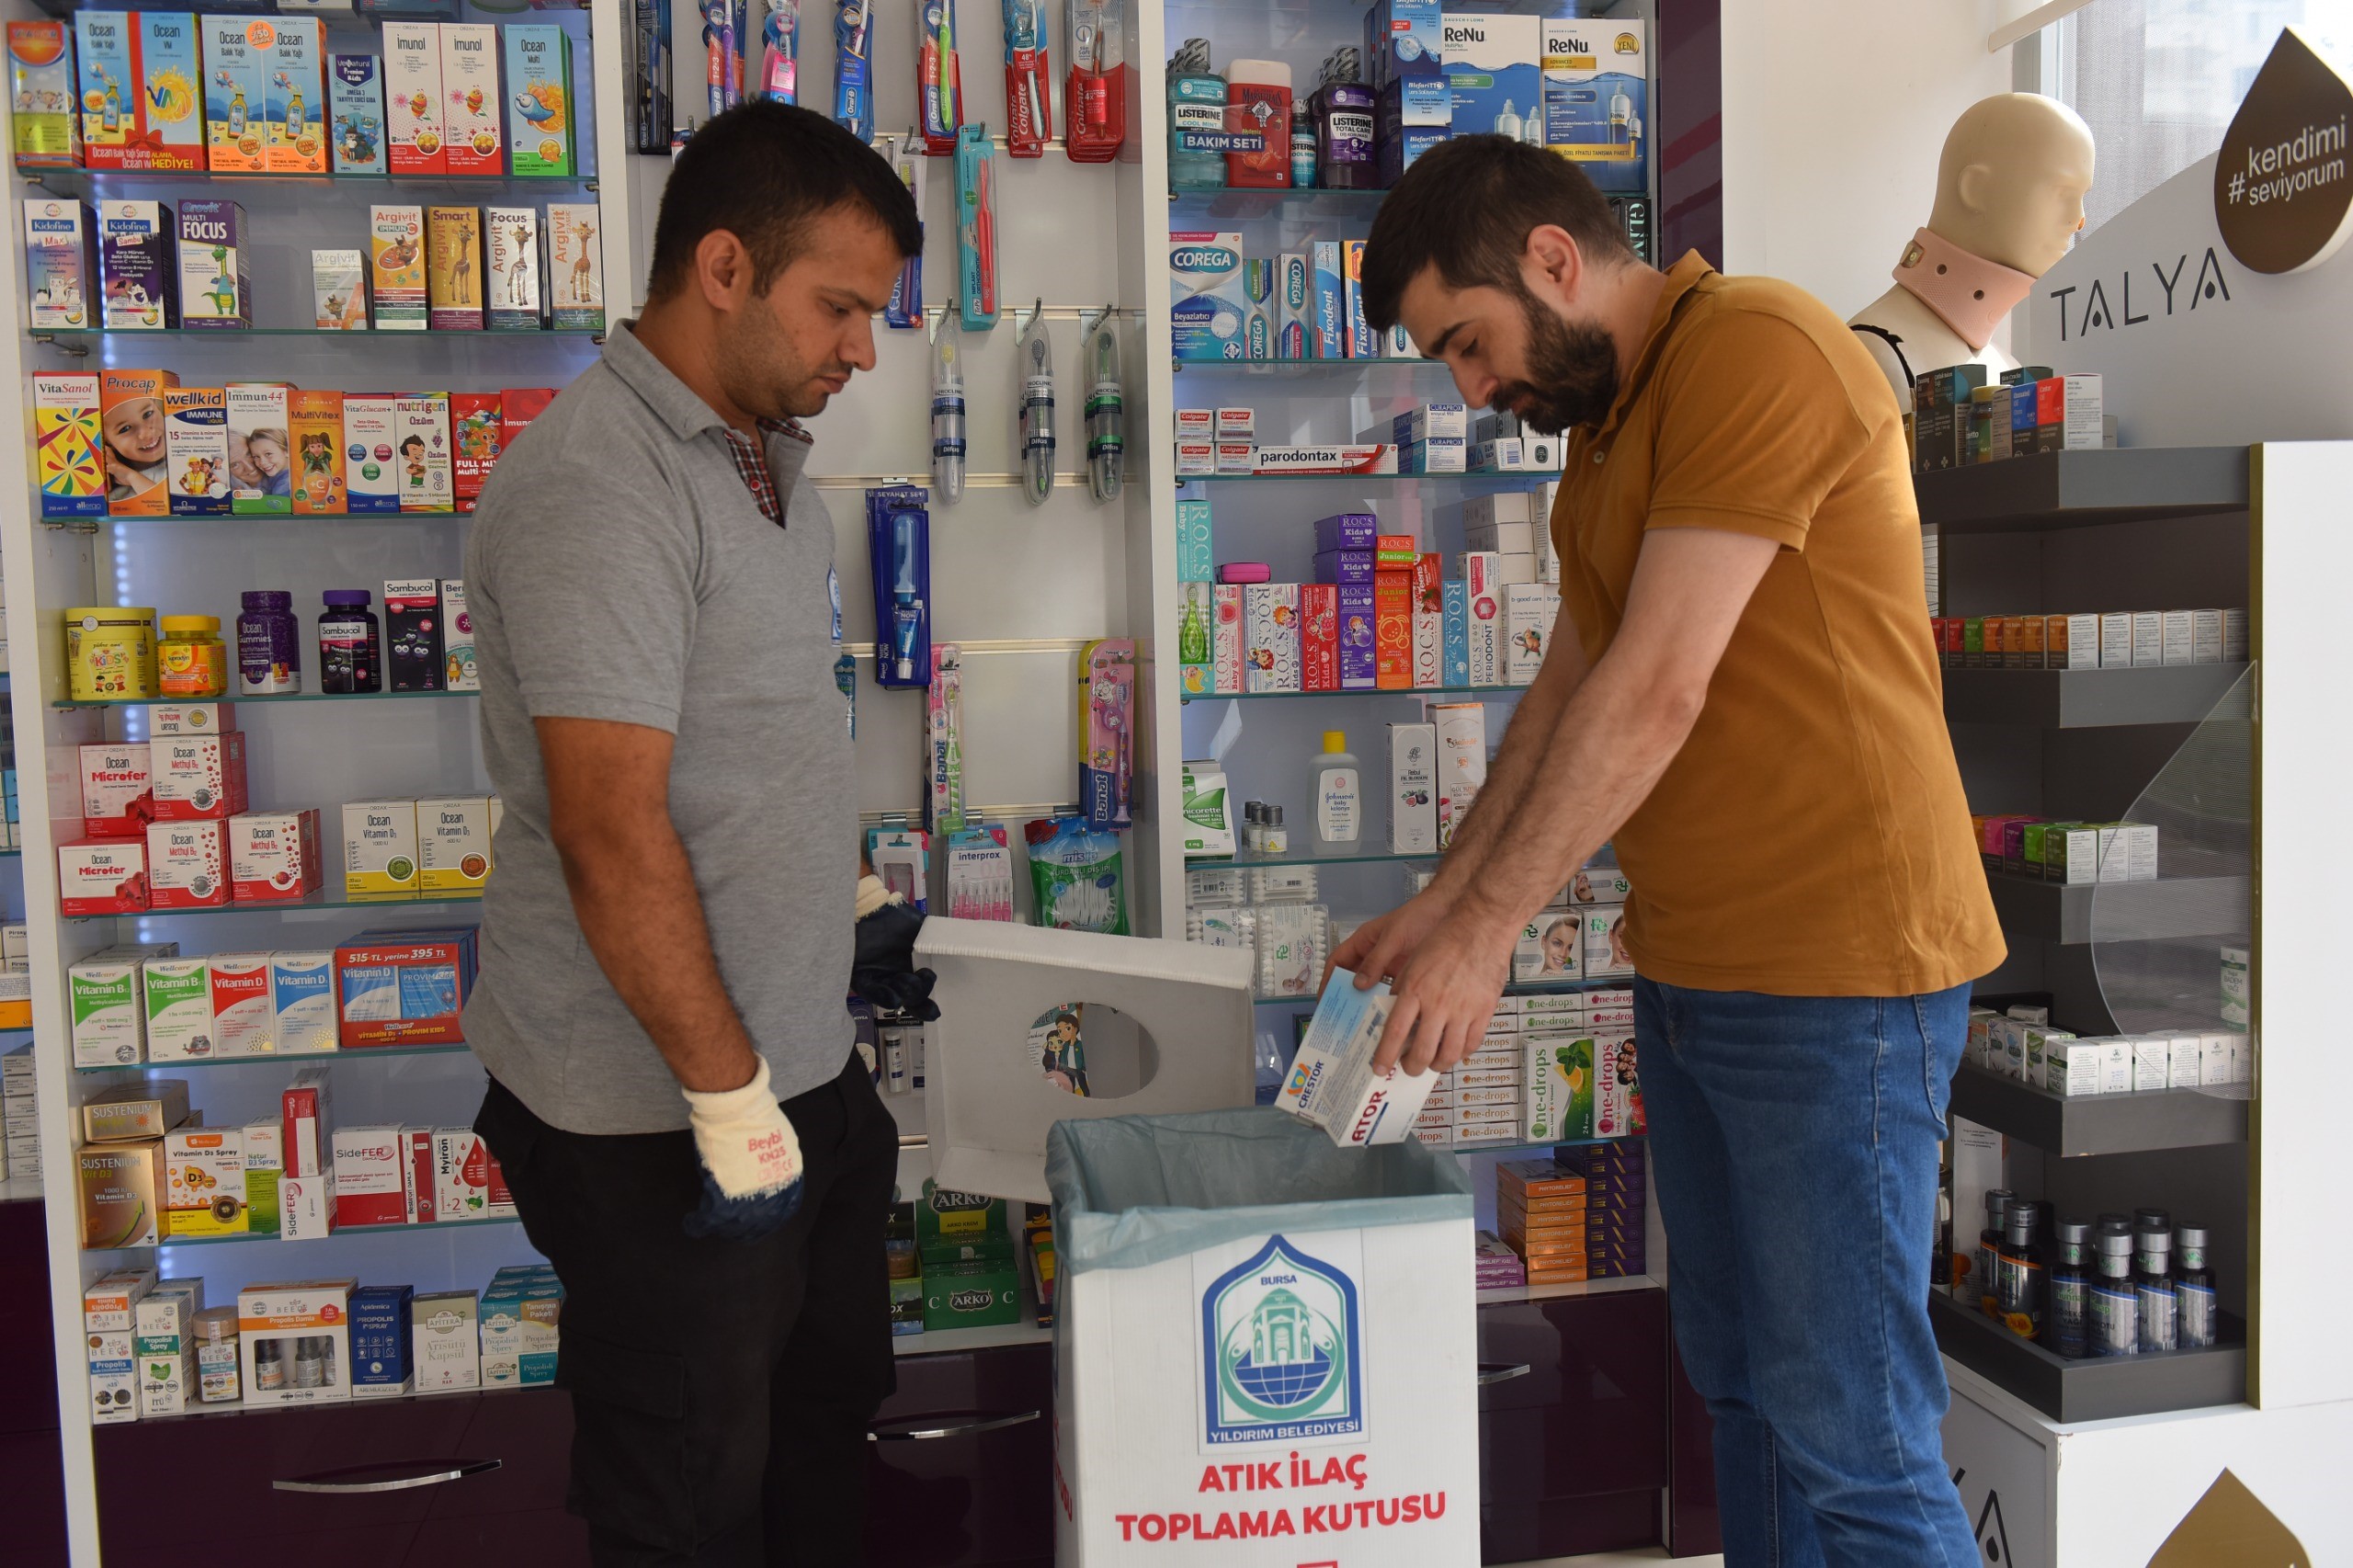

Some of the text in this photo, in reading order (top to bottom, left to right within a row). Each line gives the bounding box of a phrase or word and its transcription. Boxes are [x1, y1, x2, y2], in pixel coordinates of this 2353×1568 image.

[89, 24, 115, 37] Ocean
[154, 26, 180, 39] Ocean
[1444, 28, 1484, 41] ReNu
[220, 31, 244, 45] Ocean
[278, 33, 303, 46] Ocean
[397, 35, 426, 51] İmunol
[454, 36, 482, 51] İmunol
[521, 40, 546, 53] Ocean
[1550, 39, 1588, 53] ReNu
[1617, 40, 1636, 51] YENİ
[1017, 83, 1027, 135] Colgate
[1076, 83, 1086, 134] Colgate
[1178, 108, 1221, 120] LISTERINE
[1334, 118, 1372, 128] LISTERINE
[1187, 135, 1262, 149] BAKIM SETİ
[2249, 115, 2346, 177] kendimi
[122, 157, 142, 168] Ocean
[152, 155, 193, 169] HEDİYE!
[2249, 158, 2344, 206] seviyorum
[376, 211, 416, 222] Argivit
[433, 210, 471, 222] Smart
[491, 211, 527, 223] Focus
[34, 222, 71, 232] Kidofine
[110, 222, 147, 232] Kidofine
[184, 222, 227, 240] FOCUS
[554, 210, 567, 263] Argivit
[436, 223, 447, 272] Argivit
[493, 226, 504, 273] Argivit
[1174, 252, 1232, 267] COREGA
[1291, 262, 1302, 305] COREGA
[2051, 246, 2231, 341] TALYA
[973, 300, 982, 315] TePe
[1174, 312, 1210, 322] Beyazlatıcı
[1324, 290, 1335, 345] Fixodent
[39, 383, 92, 393] VitaSanol
[107, 377, 155, 392] Procap
[165, 392, 222, 405] wellkid
[345, 404, 392, 414] VitaGlucan+
[397, 401, 446, 413] nutrigen
[187, 411, 223, 419] IMMUNE
[291, 411, 339, 419] MultiVitex
[409, 415, 434, 426] Üzüm
[1261, 450, 1337, 466] parodontax
[1380, 552, 1404, 561] Junior
[387, 583, 433, 593] Sambucol
[243, 622, 261, 633] Ocean
[323, 626, 360, 635] Sambucol
[1322, 663, 1330, 688] Kids
[174, 747, 195, 758] Ocean
[106, 757, 130, 769] Ocean
[171, 760, 190, 770] Methyl
[936, 739, 946, 782] Banat
[92, 770, 146, 782] Microfer
[1096, 775, 1108, 823] Banat
[1183, 806, 1222, 815] nicorette
[368, 815, 391, 826] Ocean
[363, 829, 388, 839] Vitamin
[92, 855, 111, 864] Ocean
[959, 851, 1001, 862] interprox
[79, 866, 125, 876] Microfer
[349, 953, 368, 963] 515
[384, 953, 409, 962] yerine
[411, 949, 433, 959] 395
[75, 984, 117, 994] Vitamin
[215, 978, 253, 988] Vitamin
[358, 1031, 386, 1040] VİTAMİN
[1299, 1060, 1324, 1108] CRESTOR
[93, 1105, 153, 1119] SUSTENIUM
[1351, 1089, 1387, 1142] ATOR
[748, 1130, 783, 1152] Beybi
[216, 1149, 237, 1158] Sprey
[336, 1149, 384, 1158] SideFER
[441, 1139, 449, 1175] Myiron
[82, 1157, 141, 1169] SUSTENIUM
[83, 1170, 111, 1179] Vit D3
[938, 1193, 989, 1208] ARKO
[288, 1193, 297, 1235] SideFER
[1260, 1274, 1297, 1285] BURSA
[928, 1297, 939, 1309] C
[954, 1294, 990, 1305] ARKO
[1003, 1291, 1014, 1304] C
[1211, 1419, 1359, 1443] YILDIRIM BELEDİYESİ
[1199, 1451, 1368, 1494] ATIK İLAÇ
[1116, 1492, 1446, 1542] TOPLAMA KUTUSU
